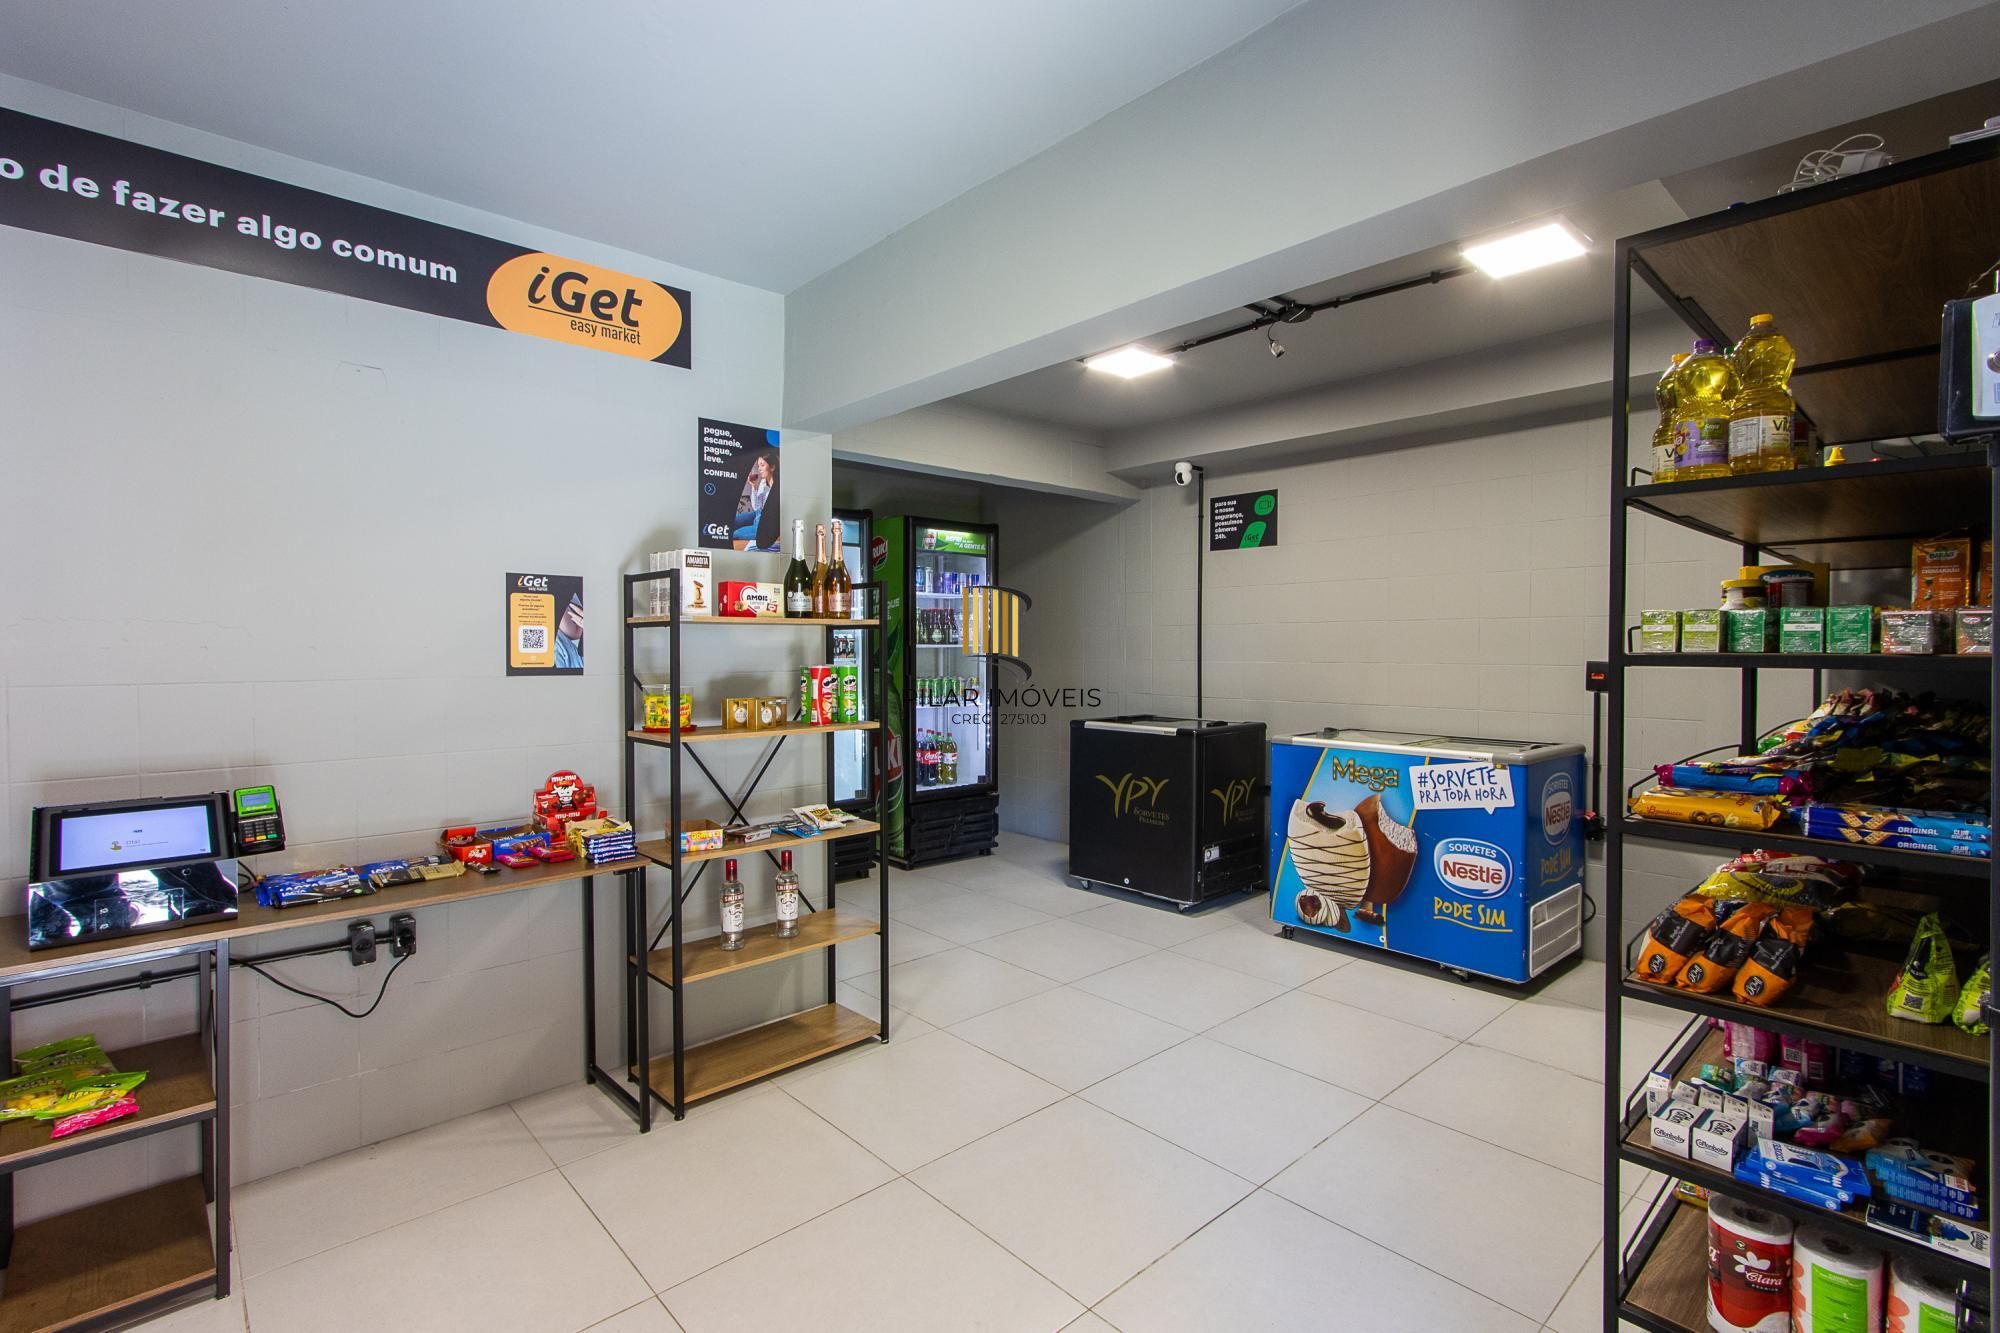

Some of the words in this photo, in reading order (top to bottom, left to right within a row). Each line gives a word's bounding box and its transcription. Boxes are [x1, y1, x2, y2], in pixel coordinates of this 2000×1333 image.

[39, 164, 99, 198] de
[112, 179, 225, 229] fazer
[236, 213, 322, 251] algo
[332, 236, 457, 284] comum
[527, 264, 643, 329] iGet
[570, 317, 599, 338] easy
[600, 324, 642, 346] market
[703, 426, 732, 438] pegue,
[703, 445, 732, 456] pague,
[703, 453, 724, 464] leve.
[703, 468, 738, 479] CONFIRA!
[1214, 512, 1244, 520] segurança,
[703, 523, 730, 537] iGet
[517, 575, 549, 588] iGet
[551, 774, 577, 783] mu-mu
[1332, 756, 1399, 792] Mega
[1417, 765, 1498, 790] #SORVETE
[1095, 772, 1170, 819] YPY
[1210, 776, 1256, 826] YPY
[1419, 789, 1441, 804] PRA
[1442, 787, 1471, 803] TODA
[1475, 786, 1508, 801] HORA
[555, 811, 581, 820] mu-mu
[1897, 826, 1939, 836] ORIGINAL
[1448, 842, 1497, 859] SORVETES
[1897, 841, 1939, 851] ORIGINAL
[371, 865, 404, 874] LACTA
[1434, 896, 1472, 922] PODE
[1477, 903, 1506, 929] SIM
[1745, 1271, 1783, 1286] Clara
